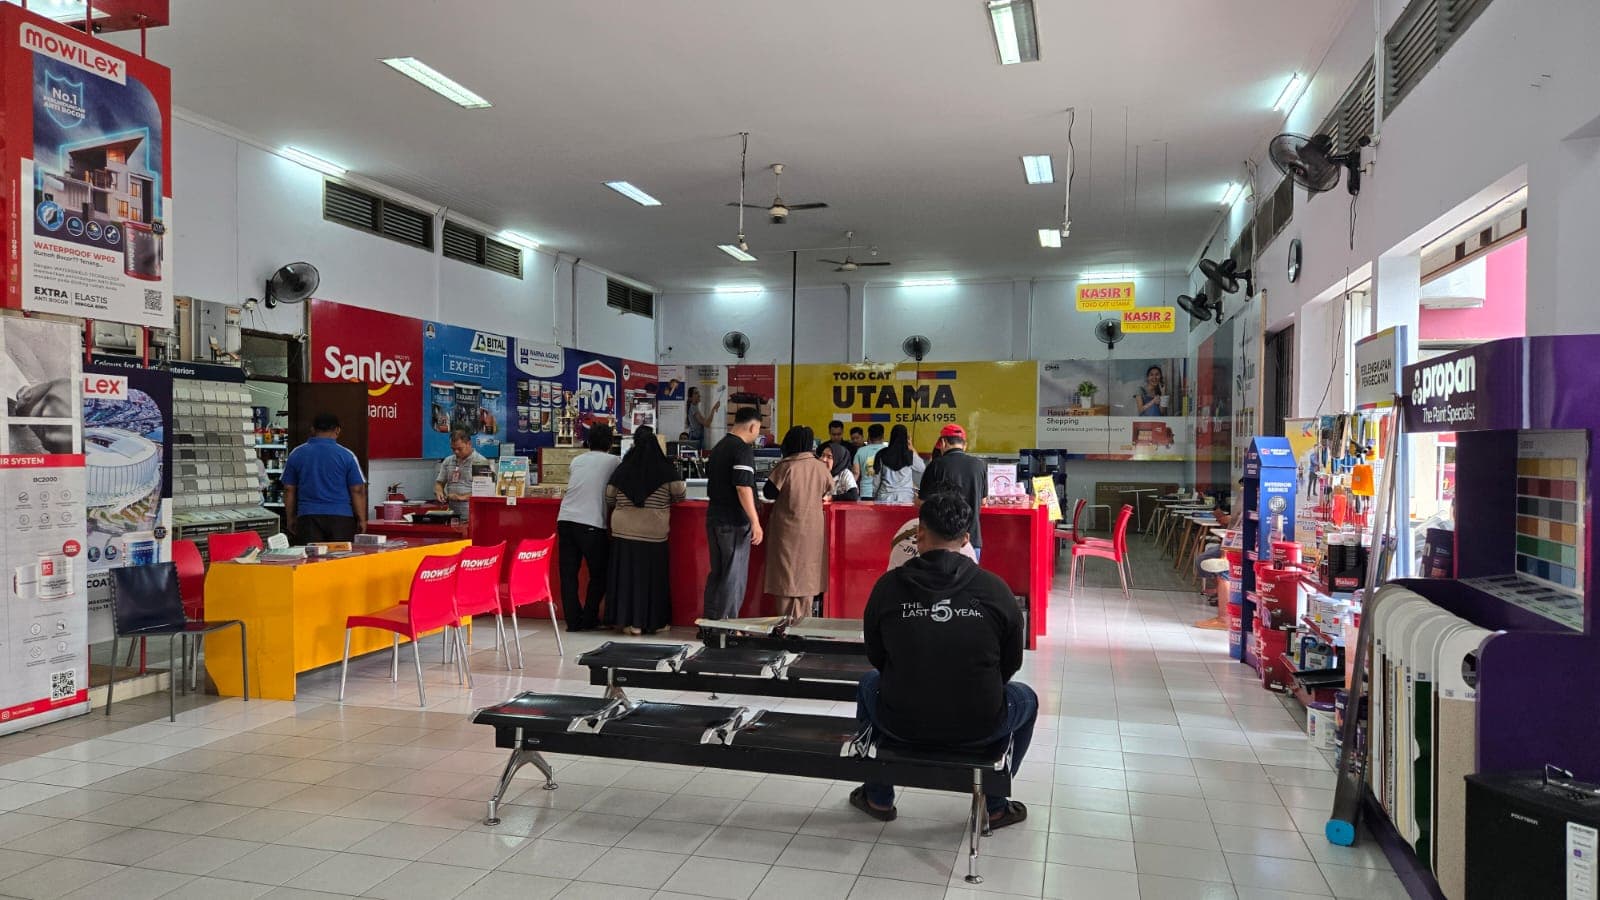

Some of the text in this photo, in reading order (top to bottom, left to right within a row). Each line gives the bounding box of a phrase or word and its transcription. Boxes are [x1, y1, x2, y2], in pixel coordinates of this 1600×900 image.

[52, 87, 77, 105] No.1
[34, 241, 116, 264] WATERPROOF WP02
[34, 286, 108, 304] EXTRA ELASTIS
[1081, 288, 1131, 298] KASIR 1
[1124, 311, 1171, 321] KASIR 2
[324, 345, 412, 386] Sanlex
[449, 360, 485, 375] EXPERT
[833, 372, 891, 381] TOKO CAT
[1423, 355, 1476, 403] propan
[580, 381, 613, 411] TOA
[833, 384, 956, 408] UTAMA
[895, 413, 956, 422] SEJAK 1955
[1046, 417, 1079, 425] Shopping
[1423, 402, 1476, 424] The Paint Specialist
[11, 457, 45, 465] SYSTEM
[902, 609, 930, 618] LAST
[930, 599, 953, 623] 5
